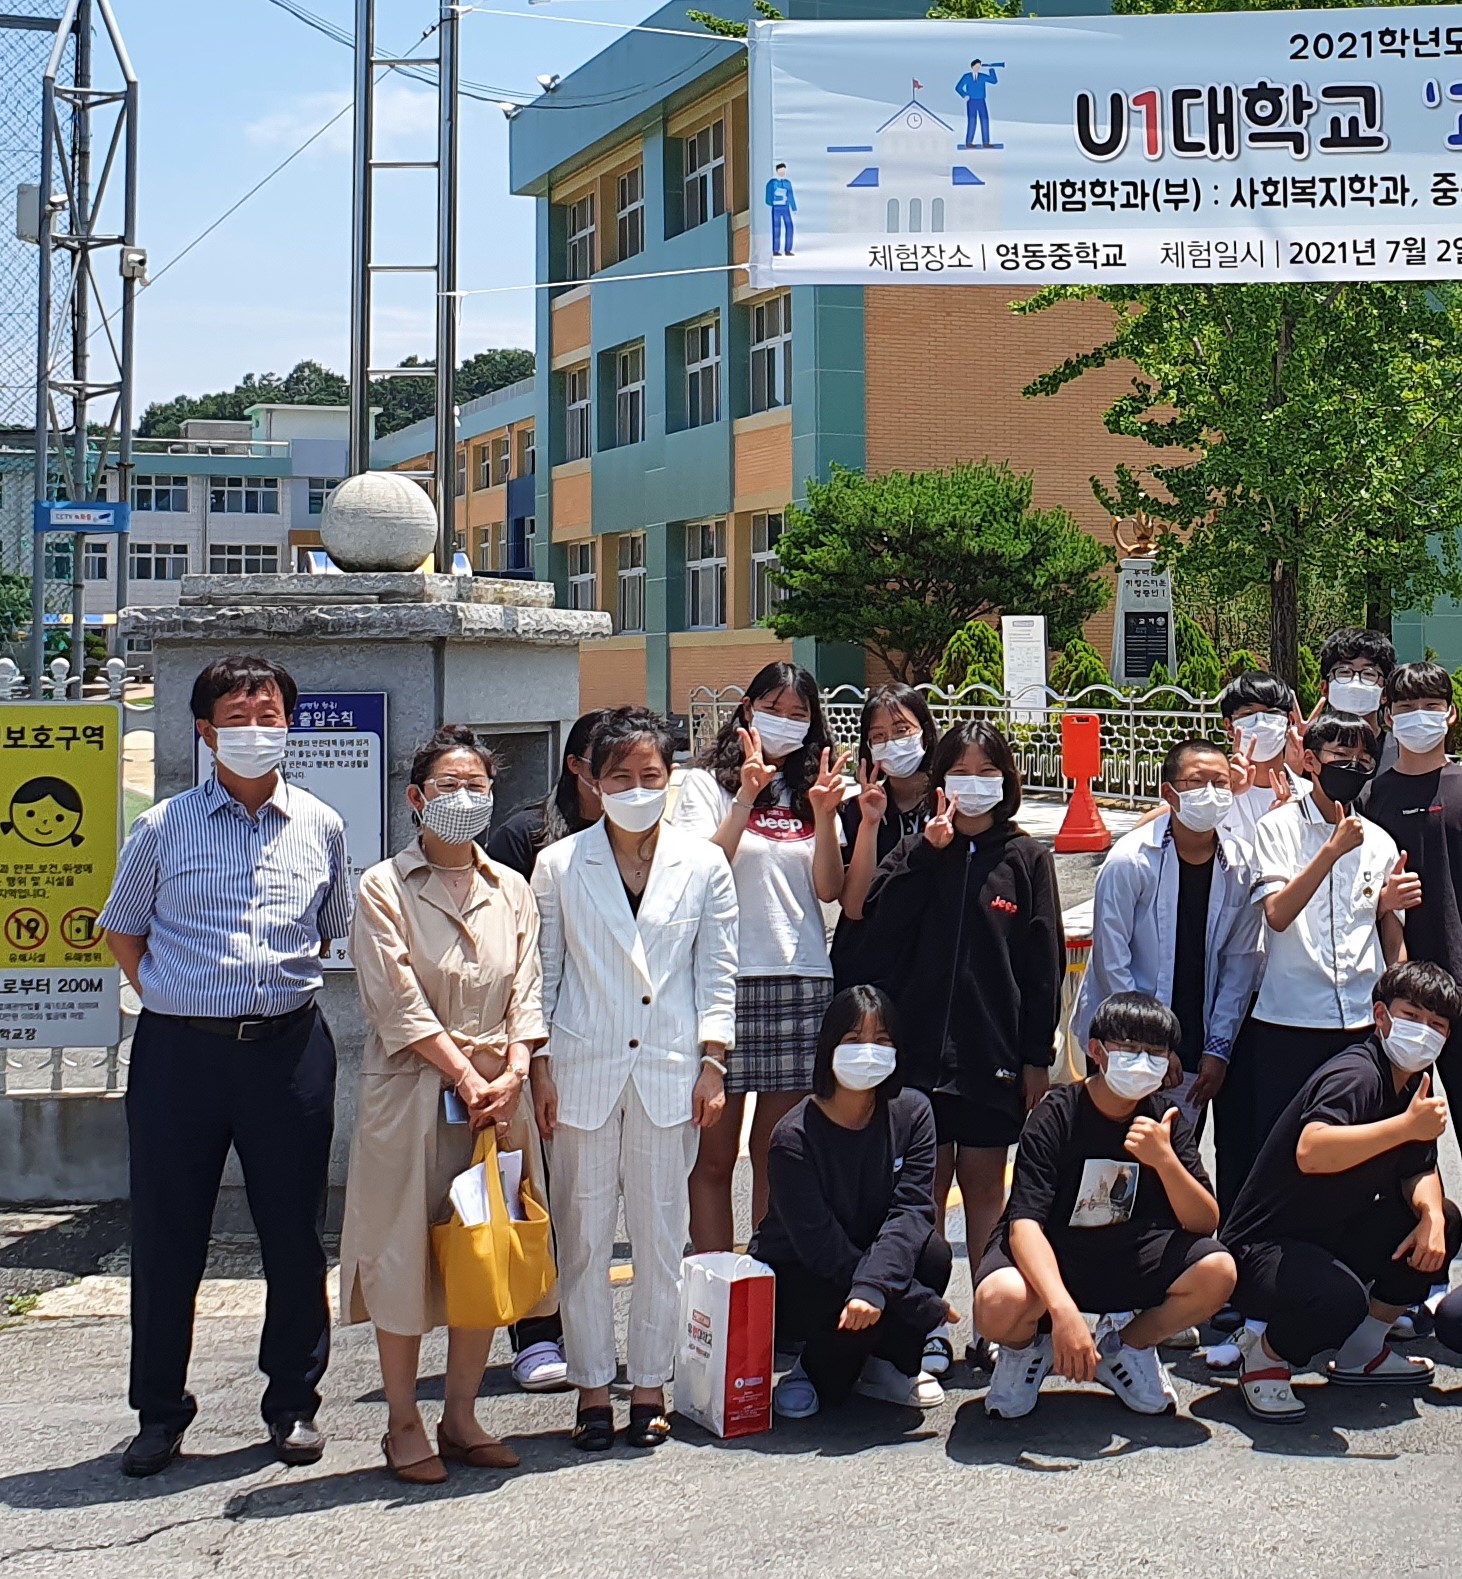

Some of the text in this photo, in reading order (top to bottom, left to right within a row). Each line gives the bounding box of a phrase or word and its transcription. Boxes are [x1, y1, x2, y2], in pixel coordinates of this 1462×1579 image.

[1079, 83, 1389, 160] U1대학교
[1030, 178, 1200, 212] 체험학과(부)
[1231, 174, 1417, 209] 사회복지학과,
[869, 244, 973, 271] 체험장소
[996, 241, 1126, 270] 영동중학교
[1161, 240, 1263, 268] 체험일시
[1290, 238, 1375, 266] 2021년
[1386, 237, 1426, 265] 7월
[299, 711, 354, 727] 출입수칙
[3, 725, 104, 751] 보호구역
[755, 813, 803, 833] Jeep
[991, 895, 1018, 913] Jeep
[57, 977, 103, 993] 200M
